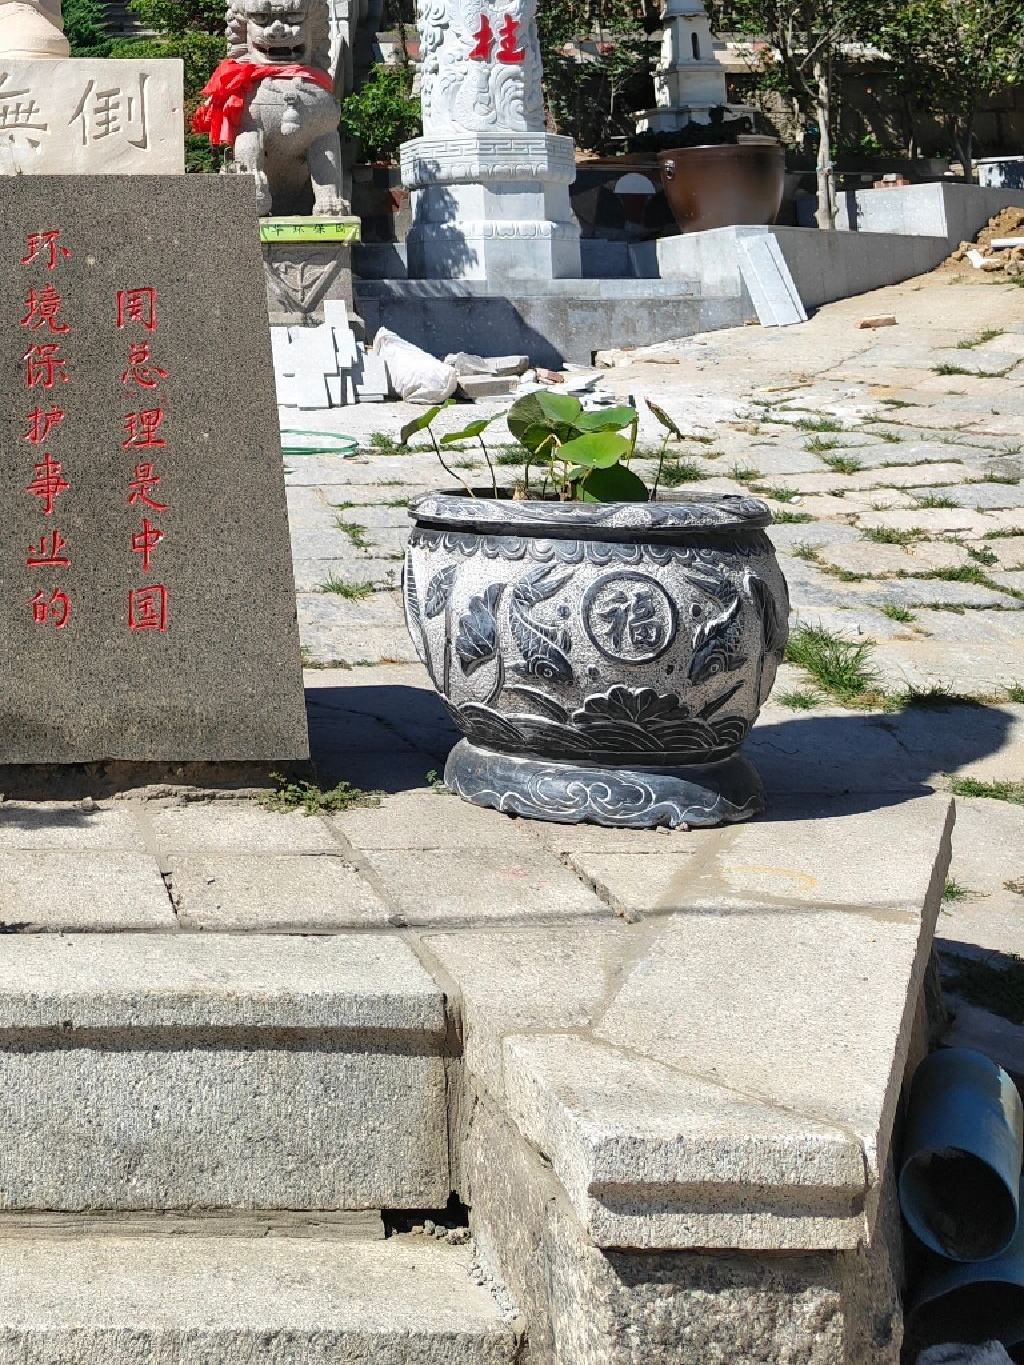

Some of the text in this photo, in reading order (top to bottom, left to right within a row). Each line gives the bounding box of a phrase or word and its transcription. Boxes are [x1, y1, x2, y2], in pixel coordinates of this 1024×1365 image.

[20, 229, 72, 630] 环境保护事业的
[115, 287, 170, 634] 周总理是中国
[596, 589, 661, 653] 福
